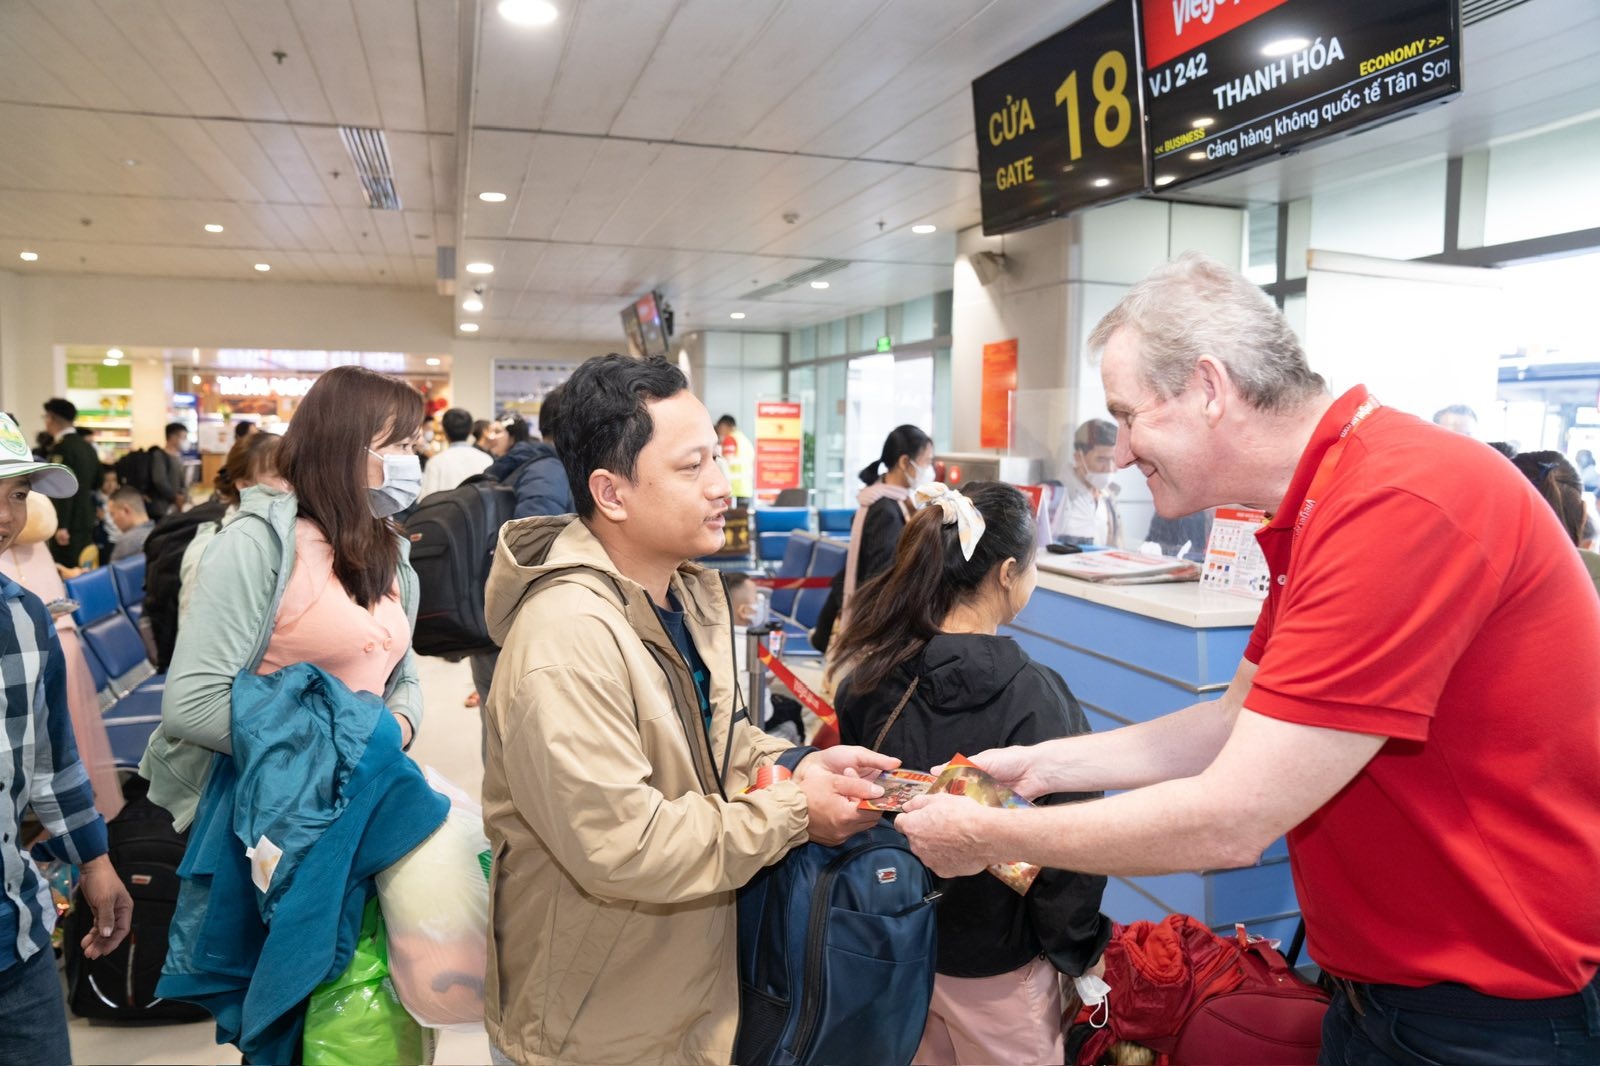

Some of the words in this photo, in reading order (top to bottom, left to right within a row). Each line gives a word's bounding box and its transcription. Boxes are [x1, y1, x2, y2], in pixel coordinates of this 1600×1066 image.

[1149, 68, 1171, 98] VJ
[1174, 52, 1208, 88] 242
[1212, 59, 1287, 110] THANH
[1292, 36, 1345, 79] HÓA
[1359, 38, 1426, 77] ECONOMY
[989, 94, 1036, 146] CỬA
[1055, 49, 1132, 161] 18
[1206, 138, 1238, 160] Cảng
[1240, 125, 1272, 149] hàng
[1275, 109, 1319, 136] không
[1322, 90, 1360, 122] quốc
[1363, 77, 1381, 104] tế
[1384, 71, 1417, 97] Tân
[1164, 127, 1206, 151] BUSINESS
[996, 155, 1035, 191] GATE
